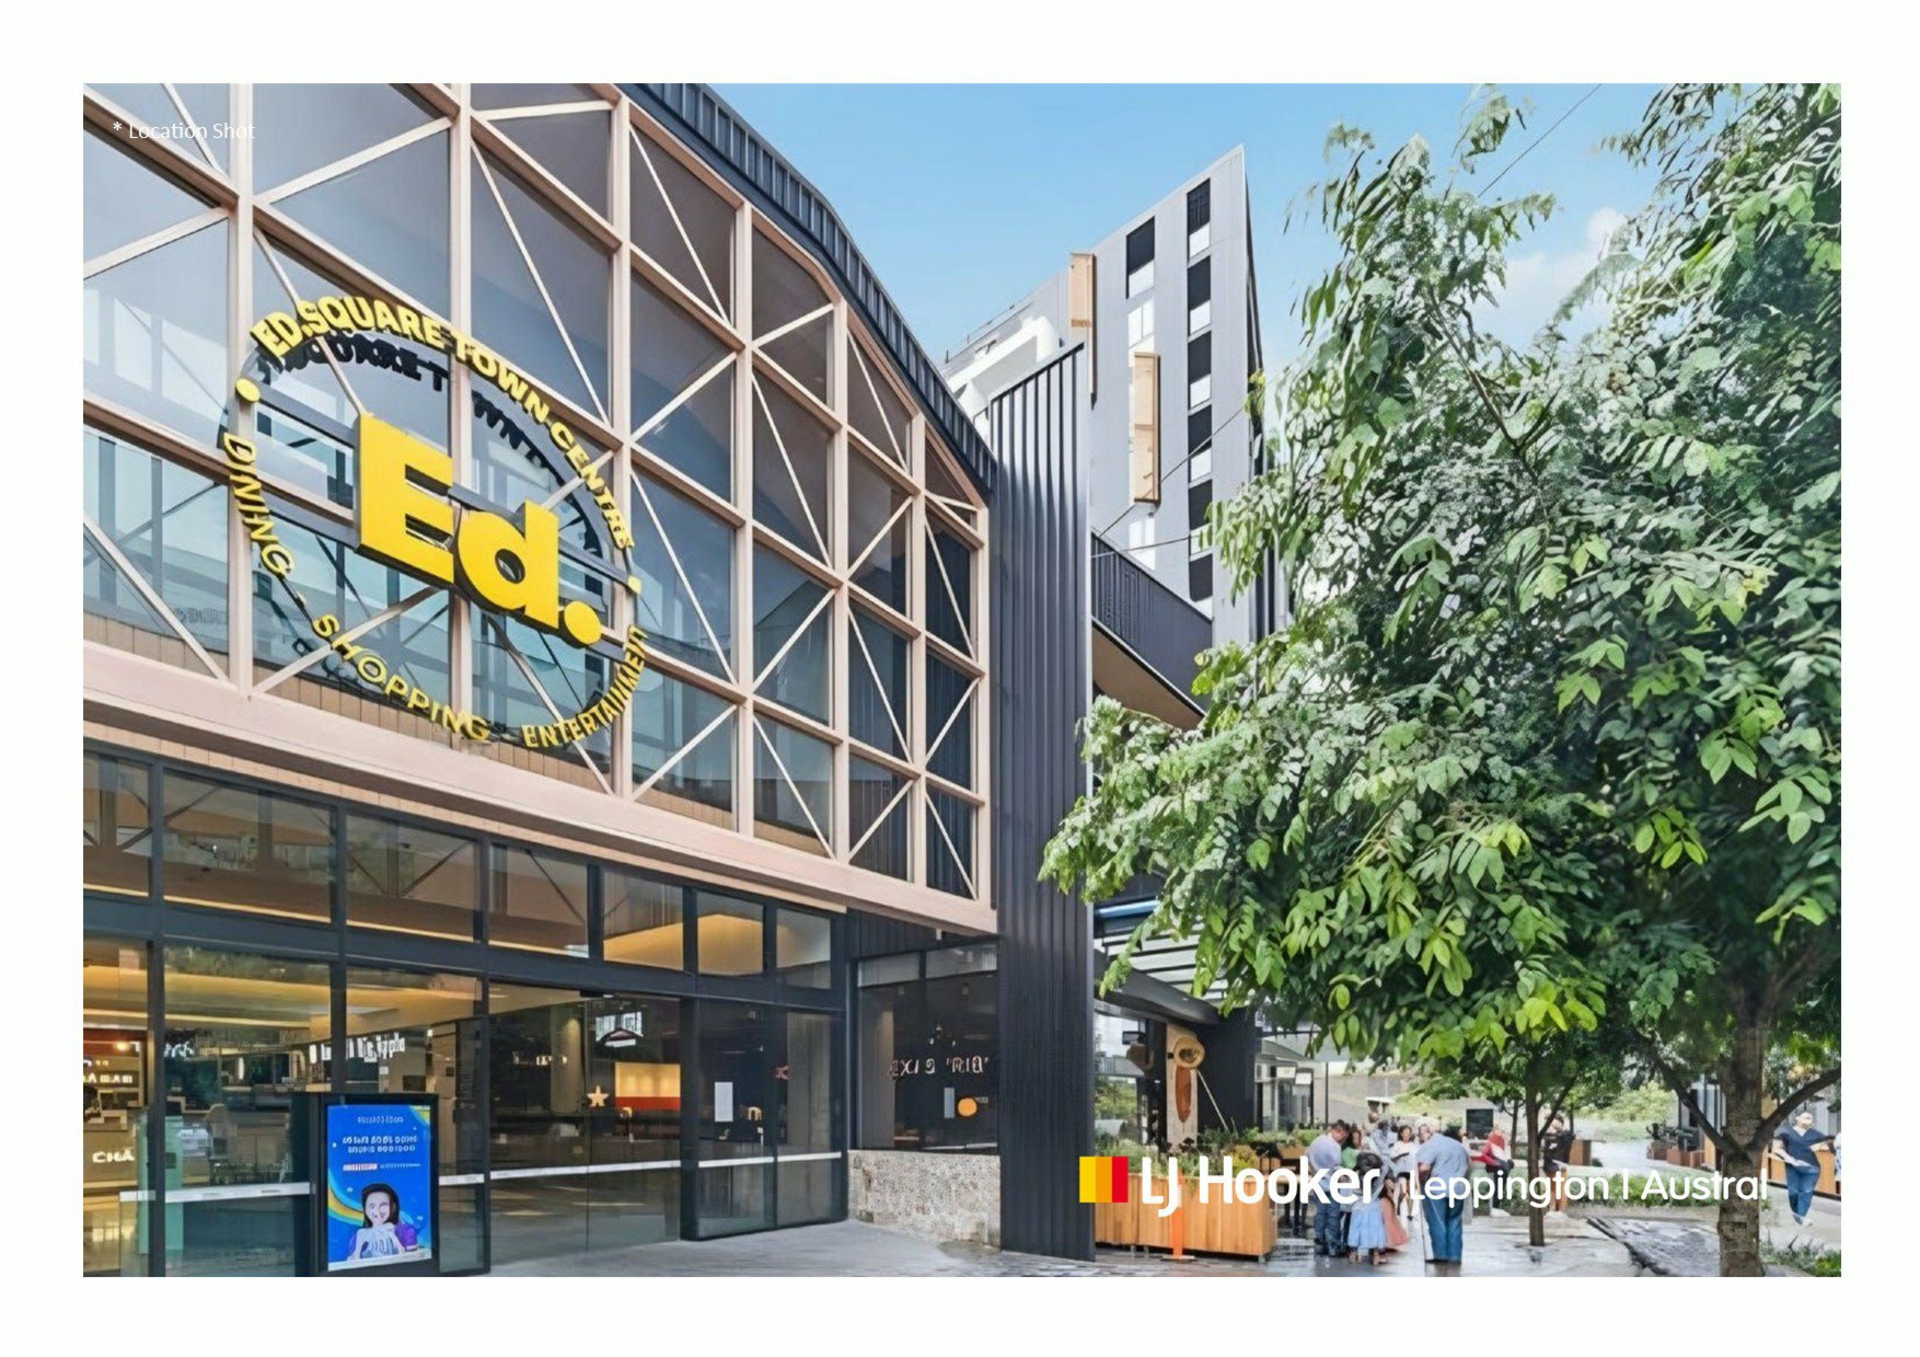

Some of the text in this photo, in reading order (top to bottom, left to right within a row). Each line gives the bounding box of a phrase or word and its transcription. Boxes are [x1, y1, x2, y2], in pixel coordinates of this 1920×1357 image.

[448, 331, 551, 424] TOWN
[223, 432, 295, 578] DINING
[356, 412, 602, 646] Ed.
[313, 614, 491, 741] SHOPPING
